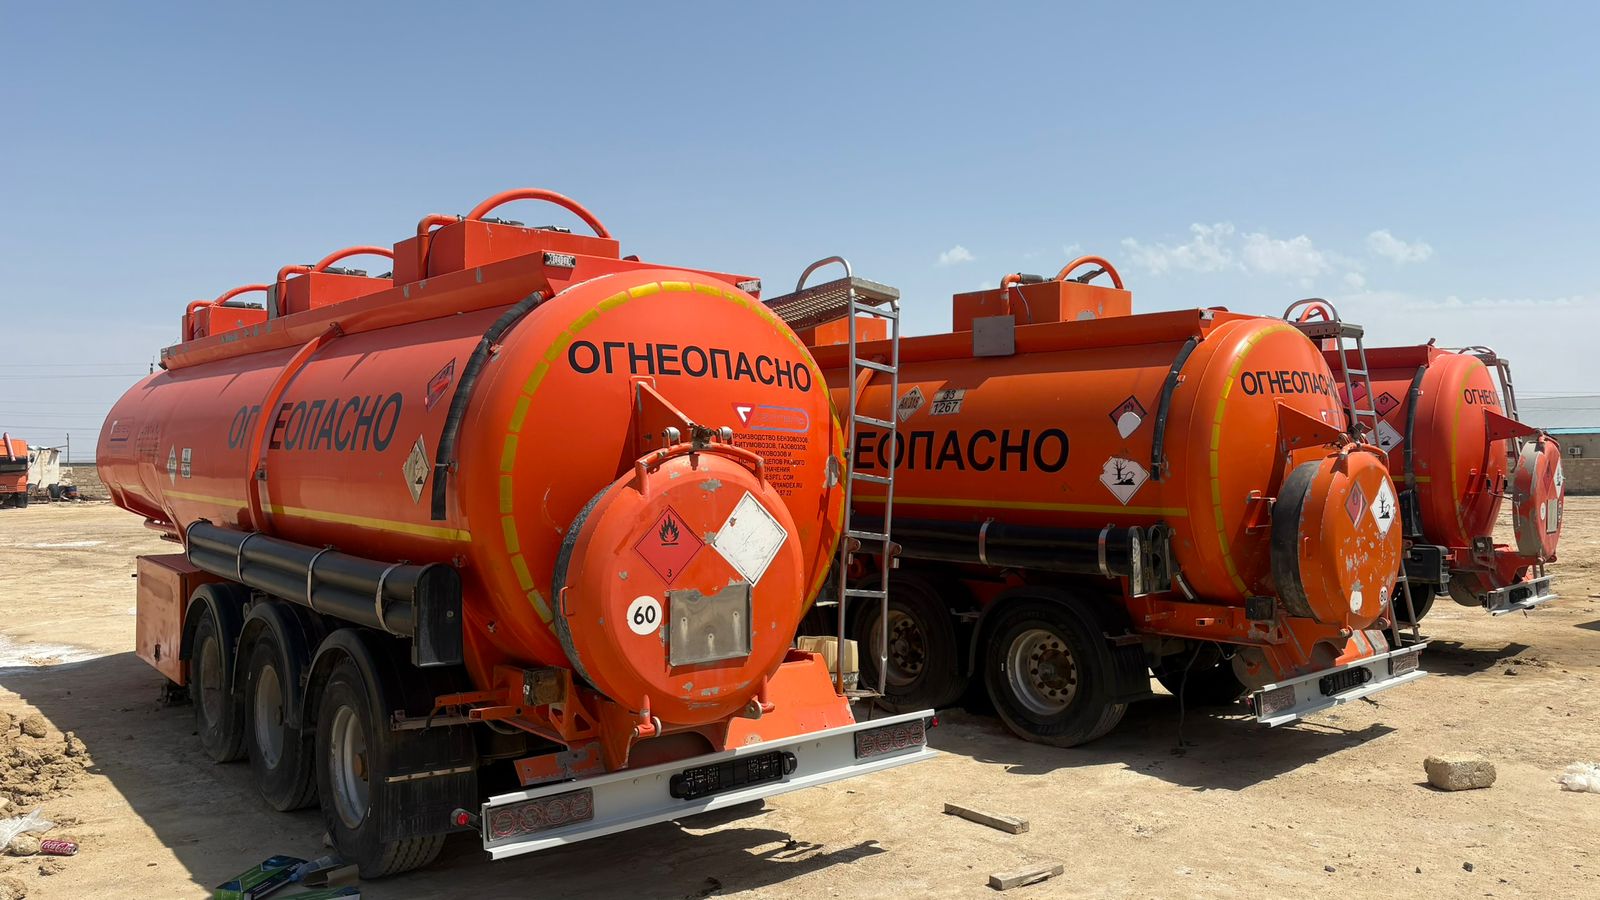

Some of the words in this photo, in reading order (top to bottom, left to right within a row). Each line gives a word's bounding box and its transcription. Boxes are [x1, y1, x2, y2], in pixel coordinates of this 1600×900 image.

[568, 340, 811, 392] ОГНЕОПАСНО
[228, 392, 403, 452] ОГЕОПАСНО
[934, 401, 958, 413] 1267
[853, 428, 1069, 473] ЕОПАСНО
[667, 569, 673, 578] 3
[633, 605, 656, 625] 60
